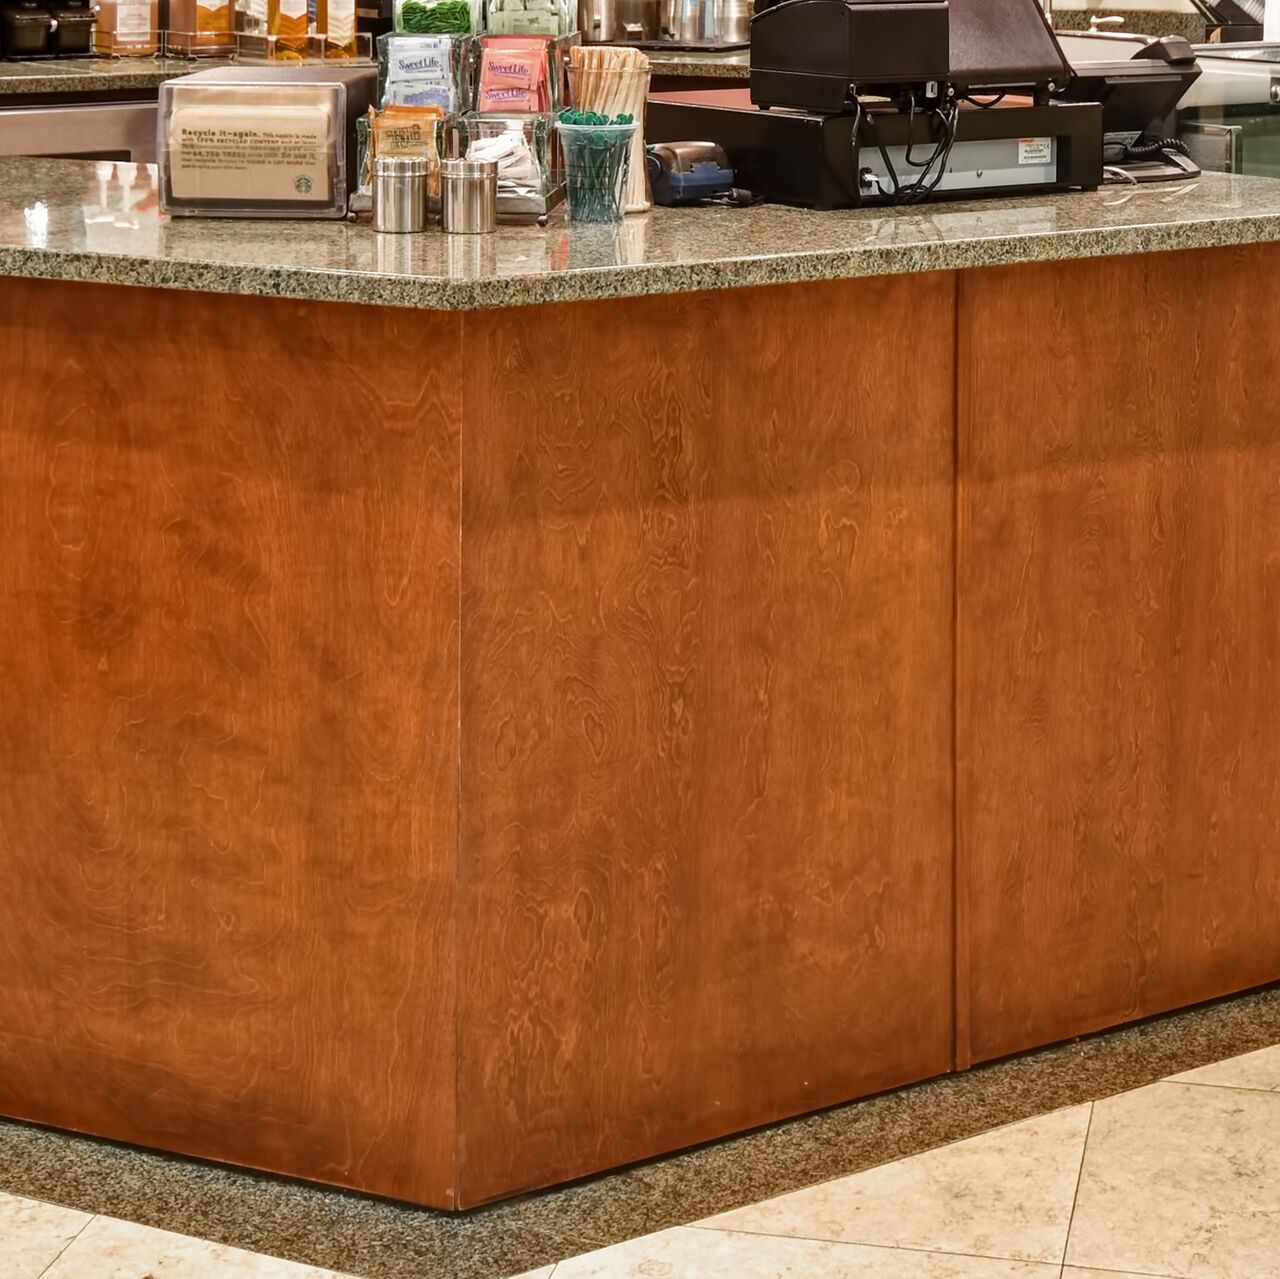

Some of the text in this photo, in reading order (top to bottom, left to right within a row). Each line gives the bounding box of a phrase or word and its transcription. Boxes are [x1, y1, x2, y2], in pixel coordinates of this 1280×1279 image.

[399, 57, 440, 71] Sweet Life
[487, 61, 529, 75] Sweet Life
[486, 88, 527, 100] Sweet Life
[181, 128, 217, 138] Recycle
